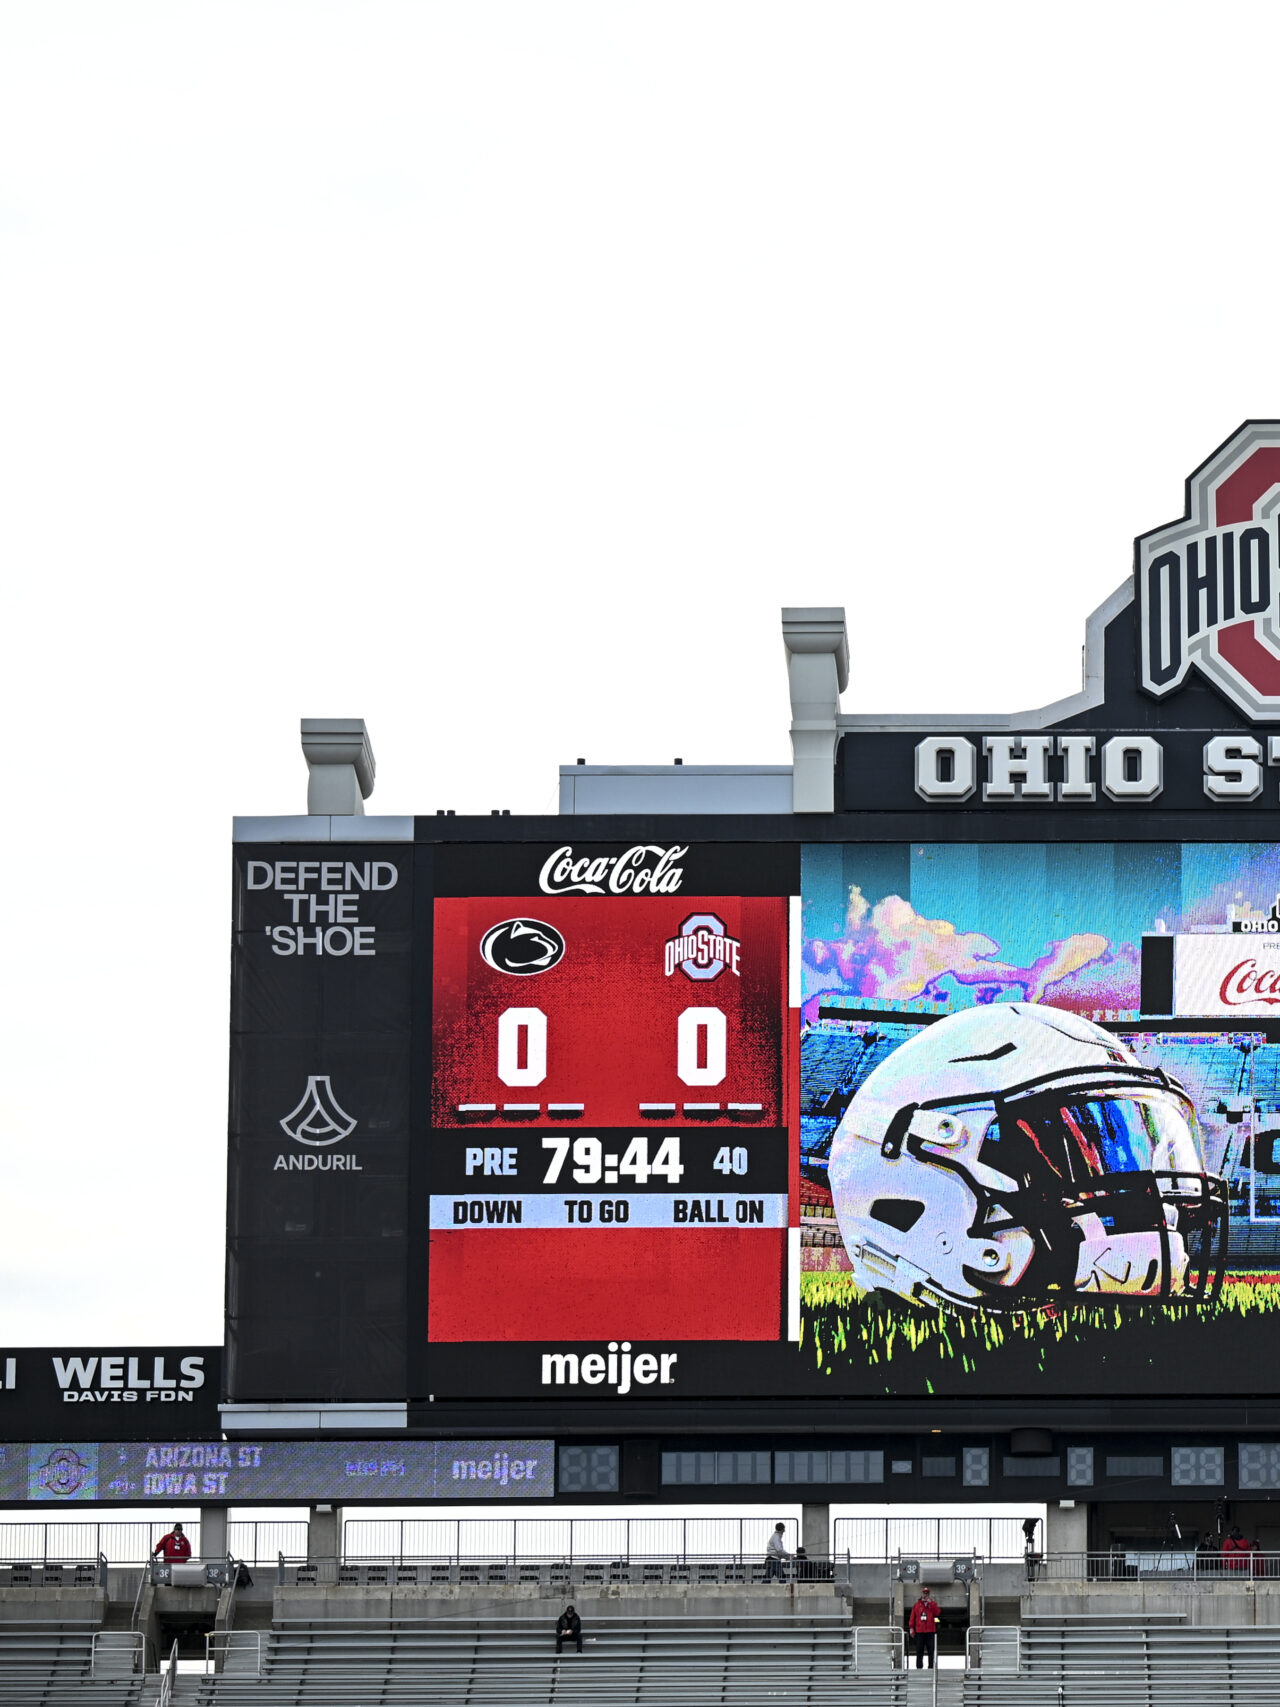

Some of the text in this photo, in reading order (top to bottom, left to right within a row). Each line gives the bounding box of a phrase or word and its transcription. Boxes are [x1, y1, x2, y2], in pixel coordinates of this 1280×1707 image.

[1148, 526, 1271, 687] OHIO
[914, 736, 1164, 802] OHIO
[247, 861, 399, 891] DEFEND
[538, 845, 689, 894] Coca-Cola
[284, 893, 359, 923] THE
[265, 926, 376, 956] 'SHOE
[1241, 920, 1279, 932] OHIO
[498, 1007, 547, 1086] 0
[677, 1007, 726, 1086] 0
[273, 1154, 363, 1171] ANDURIL
[466, 1147, 517, 1176] PRE
[541, 1137, 684, 1183] 79:44
[713, 1147, 748, 1175] 40
[453, 1201, 522, 1224] DOWN
[564, 1200, 629, 1223] TO GO
[673, 1199, 764, 1223] BALL ON
[0, 1357, 16, 1389] I
[52, 1356, 205, 1389] WELLS
[542, 1342, 677, 1394] meijer
[63, 1390, 194, 1402] DAVIS FDN
[145, 1446, 262, 1468] ARIZONA ST
[451, 1452, 538, 1485] meijer
[144, 1472, 197, 1494] IOWA
[202, 1471, 229, 1494] ST
